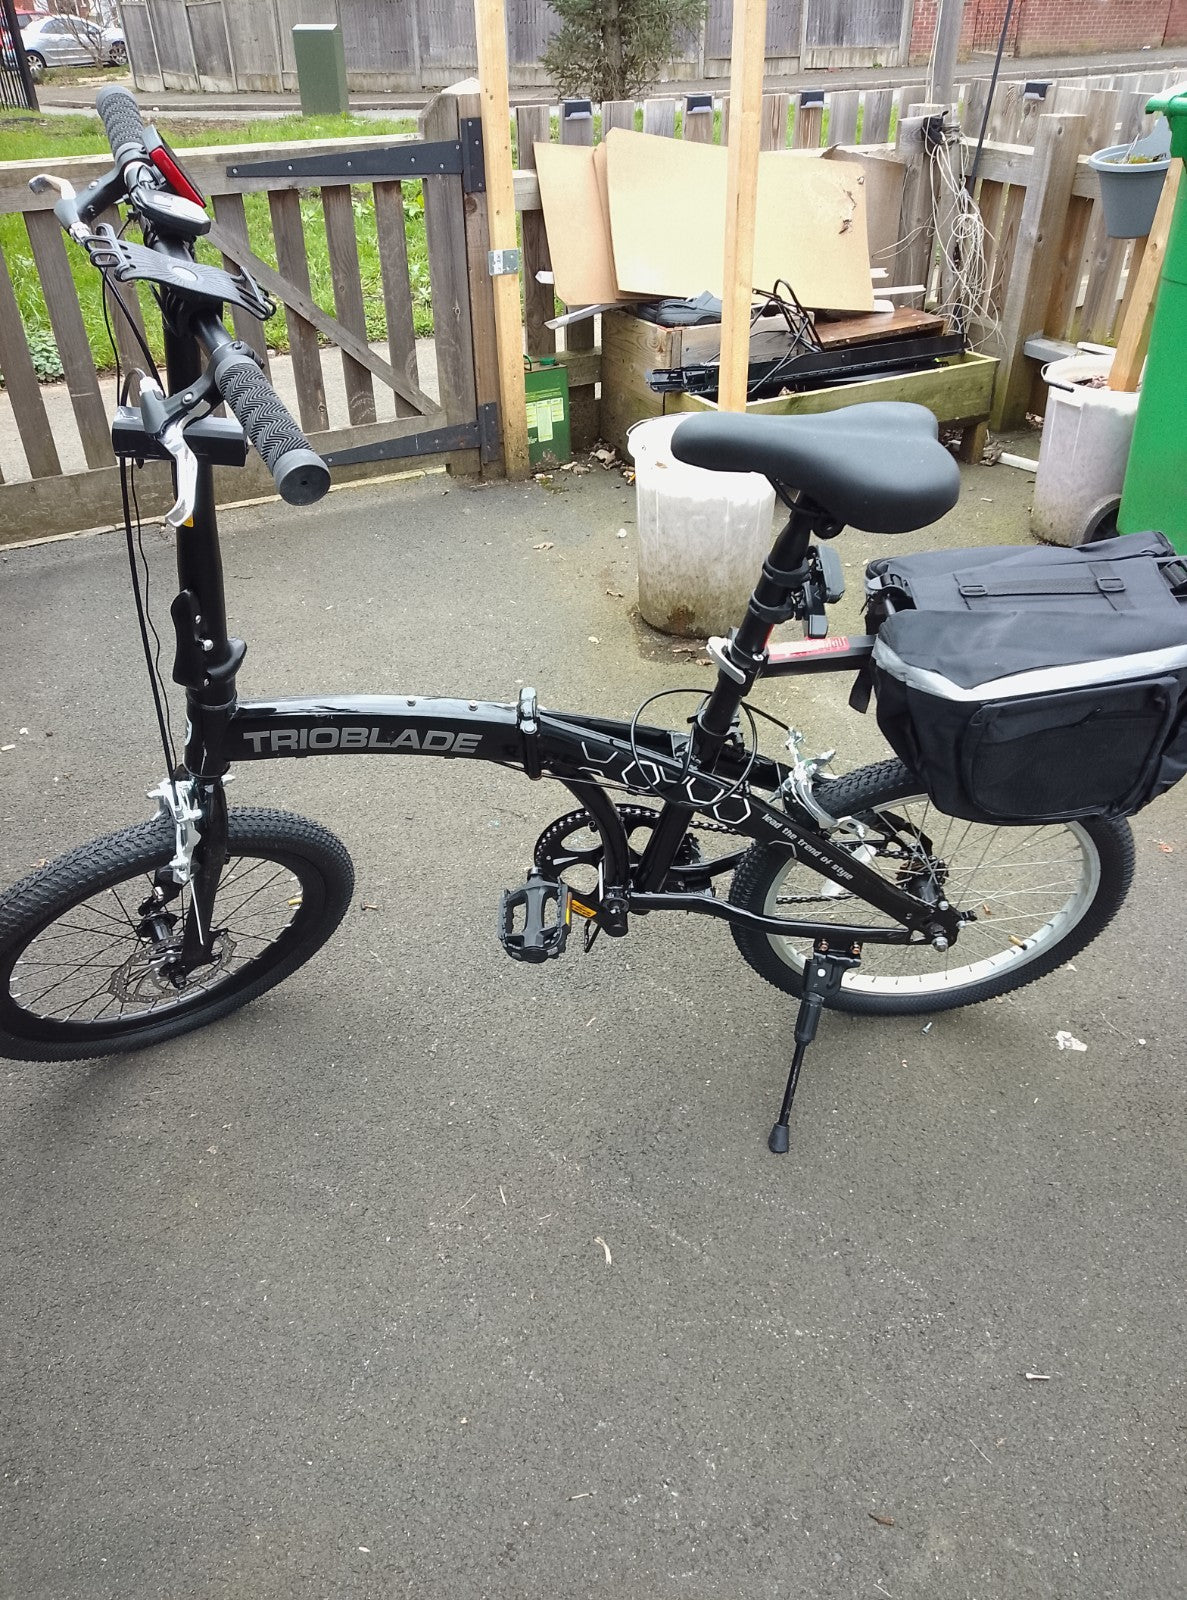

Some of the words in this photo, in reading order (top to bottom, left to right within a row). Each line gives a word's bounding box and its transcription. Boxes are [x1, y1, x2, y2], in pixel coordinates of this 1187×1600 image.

[243, 727, 483, 754] TRIOBLADE
[782, 828, 798, 840] the
[797, 839, 822, 857] trend
[820, 856, 833, 865] of
[831, 864, 854, 880] style
